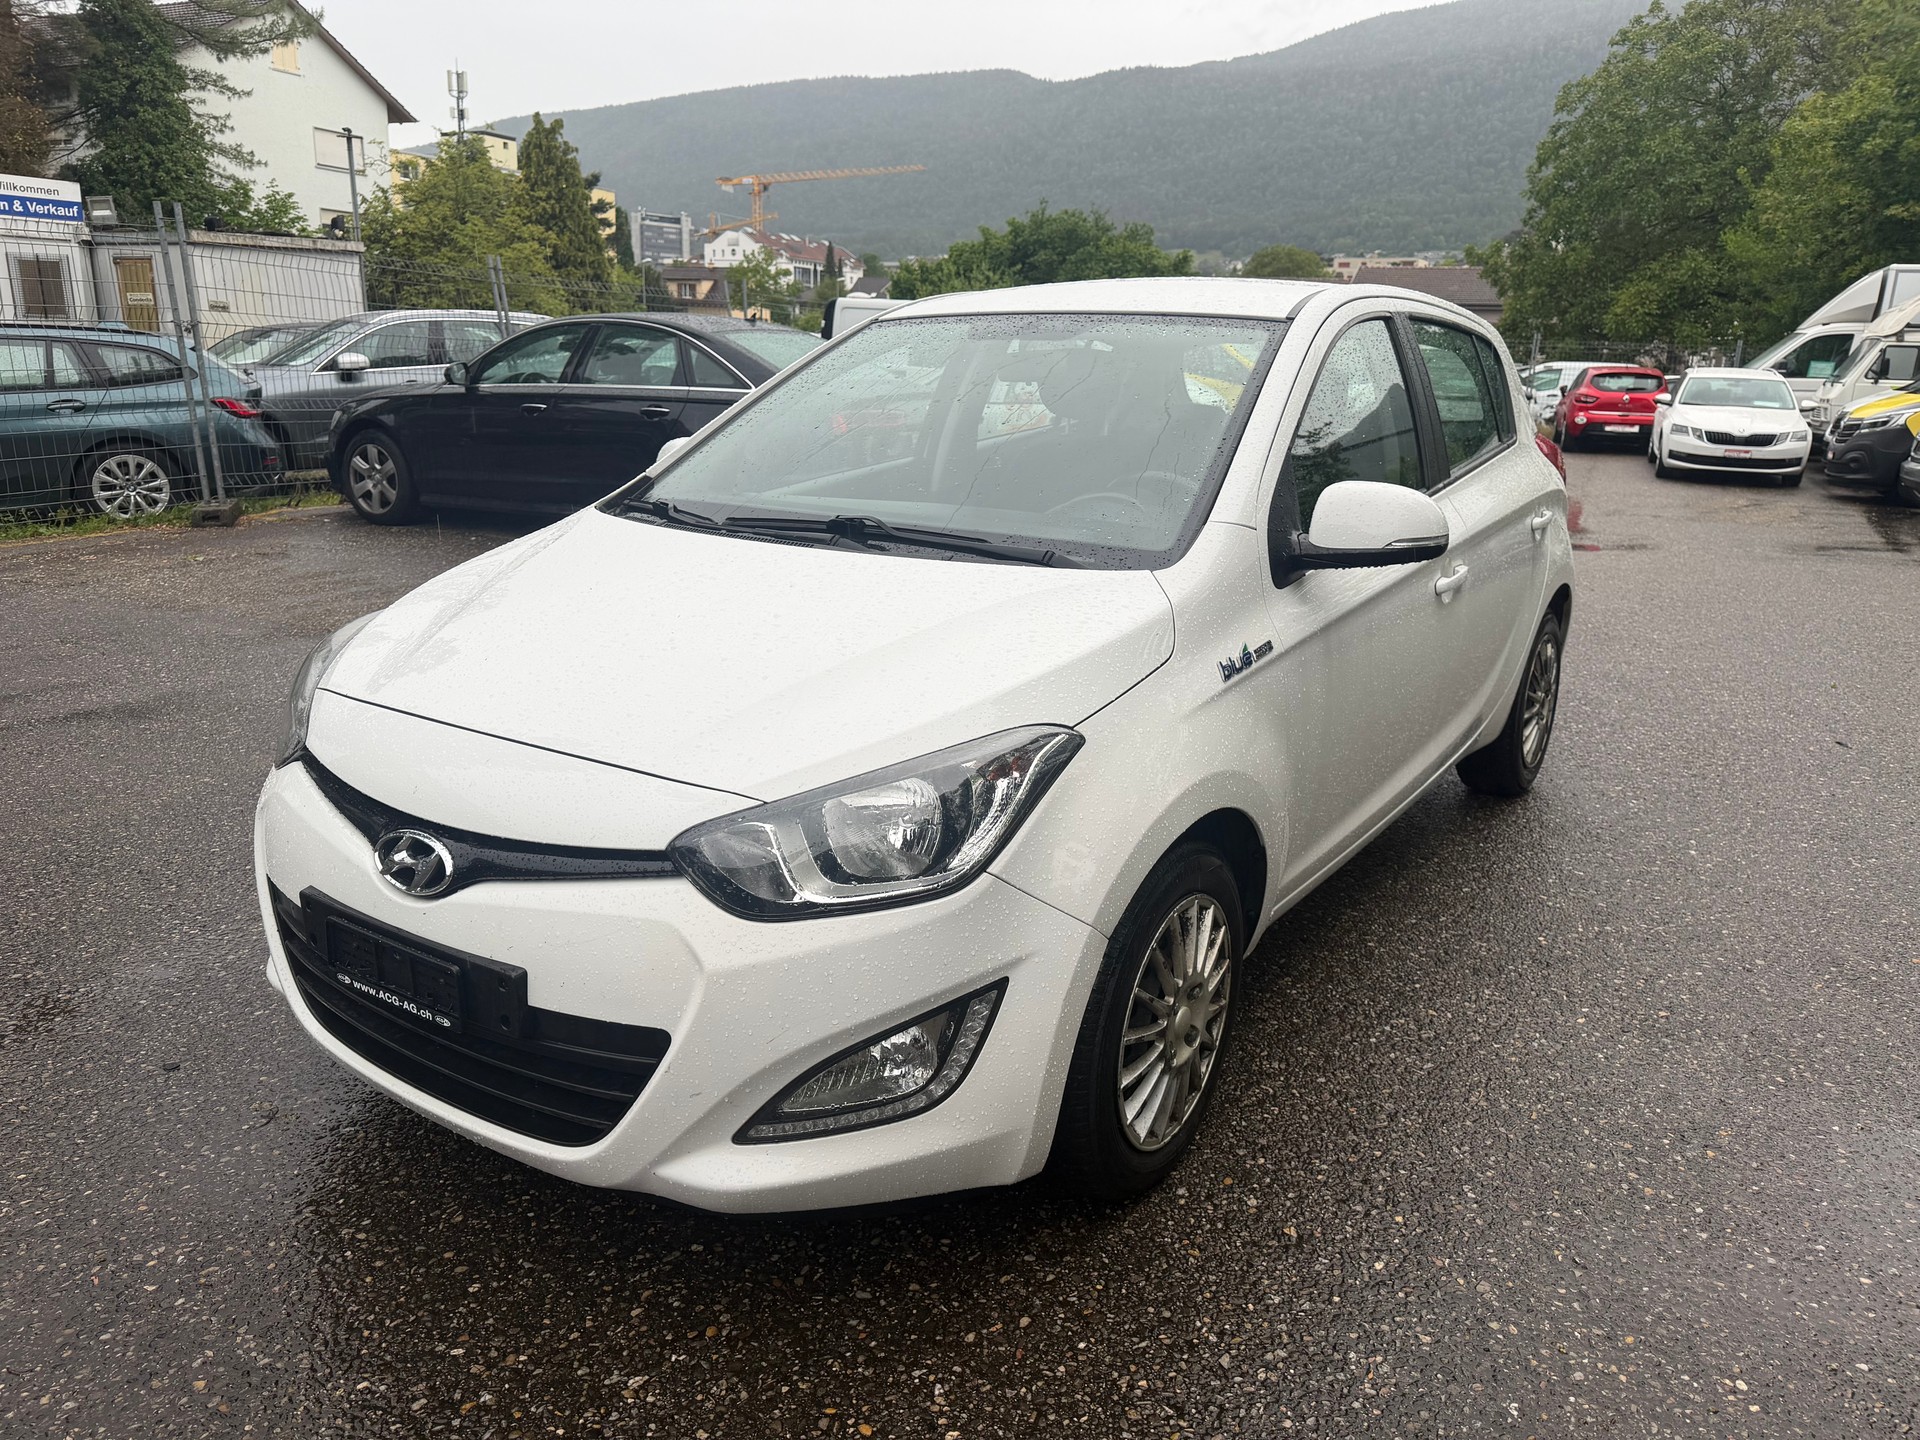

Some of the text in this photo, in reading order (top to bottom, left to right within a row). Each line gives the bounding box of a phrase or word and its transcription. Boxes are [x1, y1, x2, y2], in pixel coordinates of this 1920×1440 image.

[0, 181, 60, 196] illkommen
[13, 200, 24, 212] &
[26, 201, 79, 217] Verkauf
[1216, 648, 1254, 683] blue
[352, 980, 433, 1021] www.ACG-AG.ch
